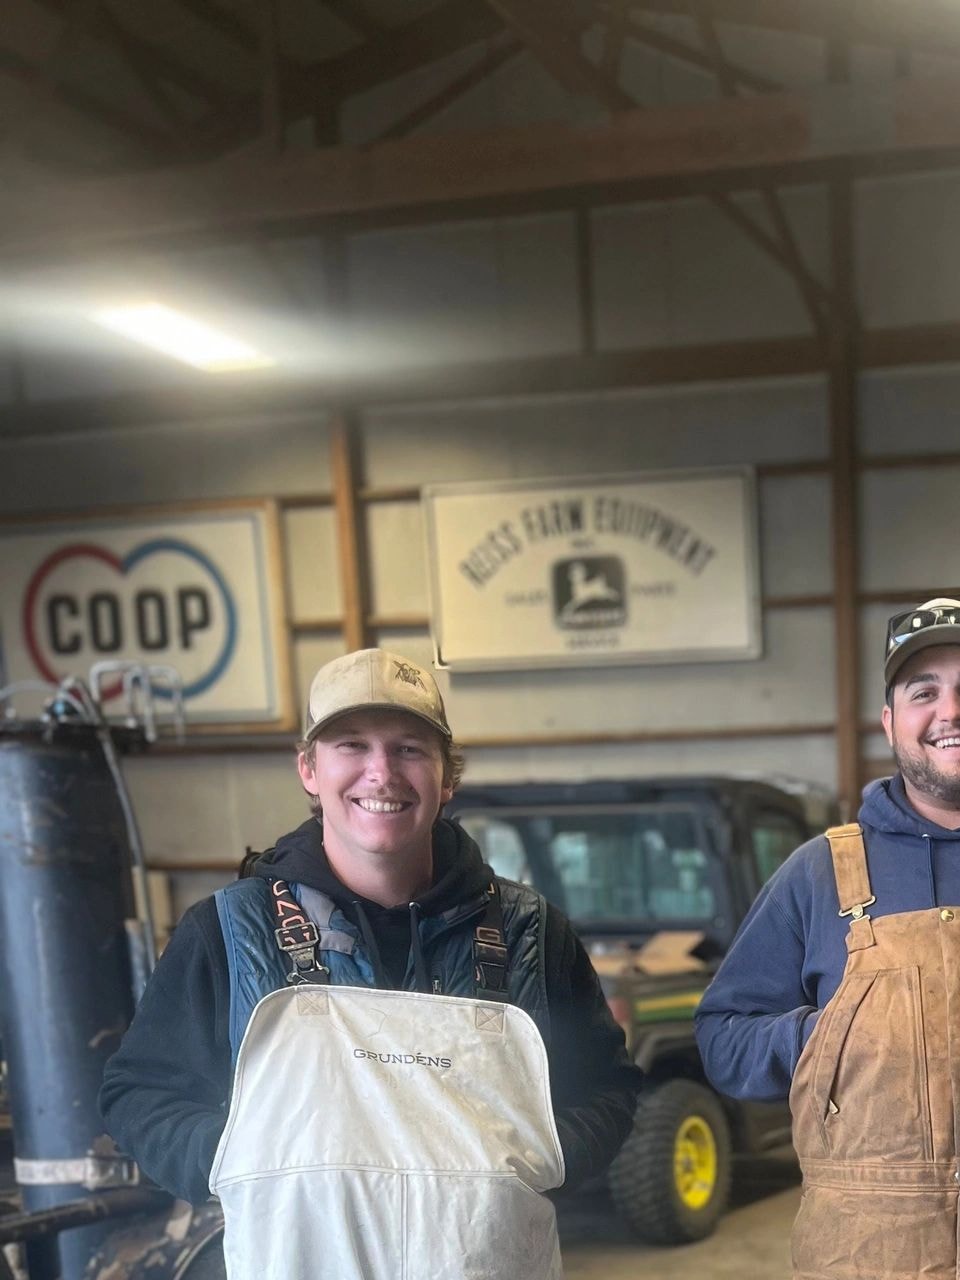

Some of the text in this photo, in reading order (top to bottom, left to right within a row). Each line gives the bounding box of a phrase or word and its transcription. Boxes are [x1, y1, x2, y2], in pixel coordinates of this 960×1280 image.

[520, 498, 584, 542] FARM
[594, 498, 718, 577] EQUIPMENT
[353, 1048, 452, 1068] GRUNDÉNS
